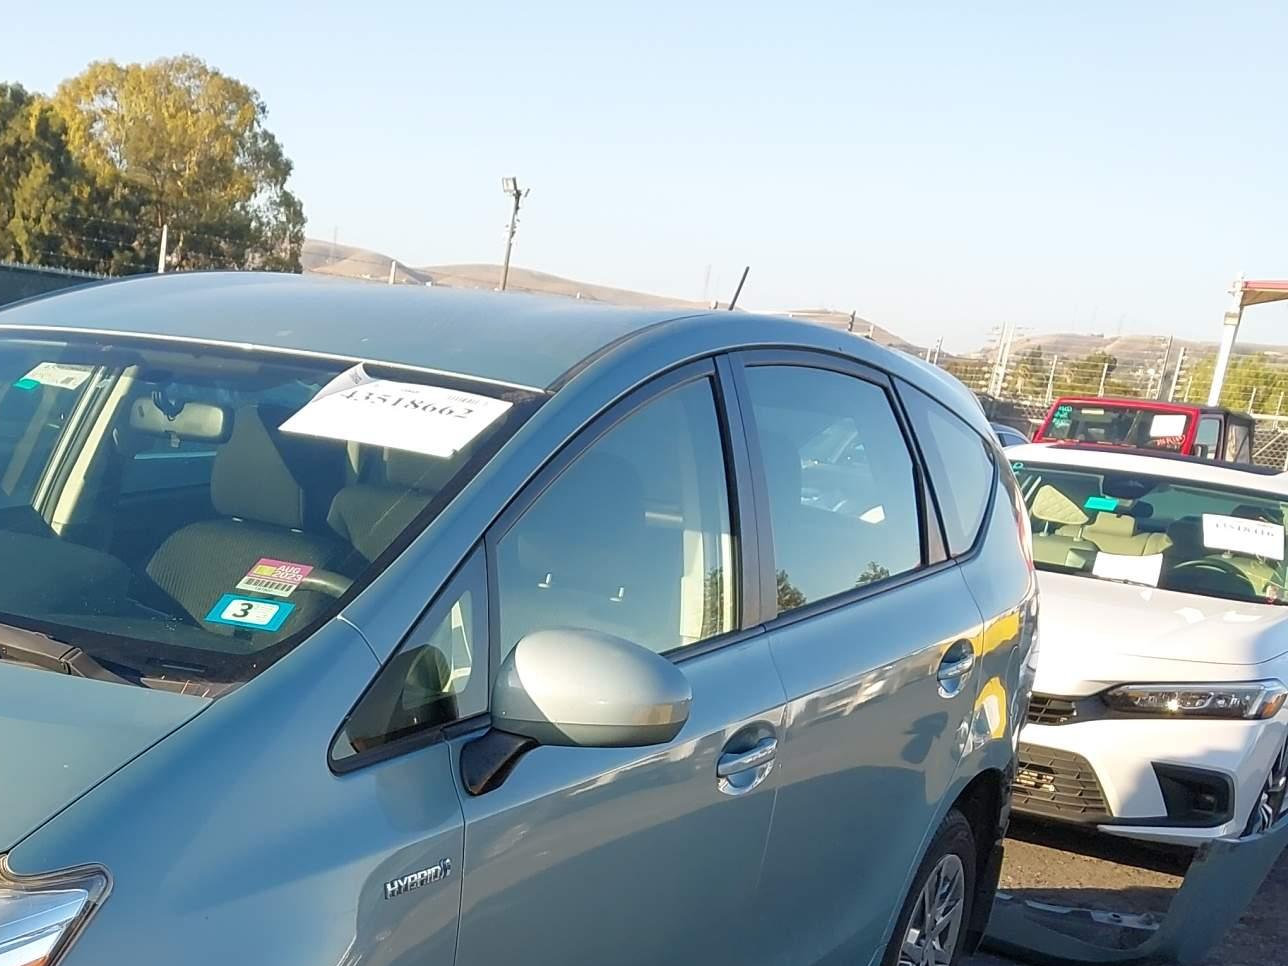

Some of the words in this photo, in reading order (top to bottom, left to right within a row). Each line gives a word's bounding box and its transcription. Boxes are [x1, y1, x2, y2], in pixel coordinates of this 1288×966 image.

[340, 390, 474, 419] 43518662
[232, 603, 253, 618] 3
[384, 865, 442, 899] HYBRID
